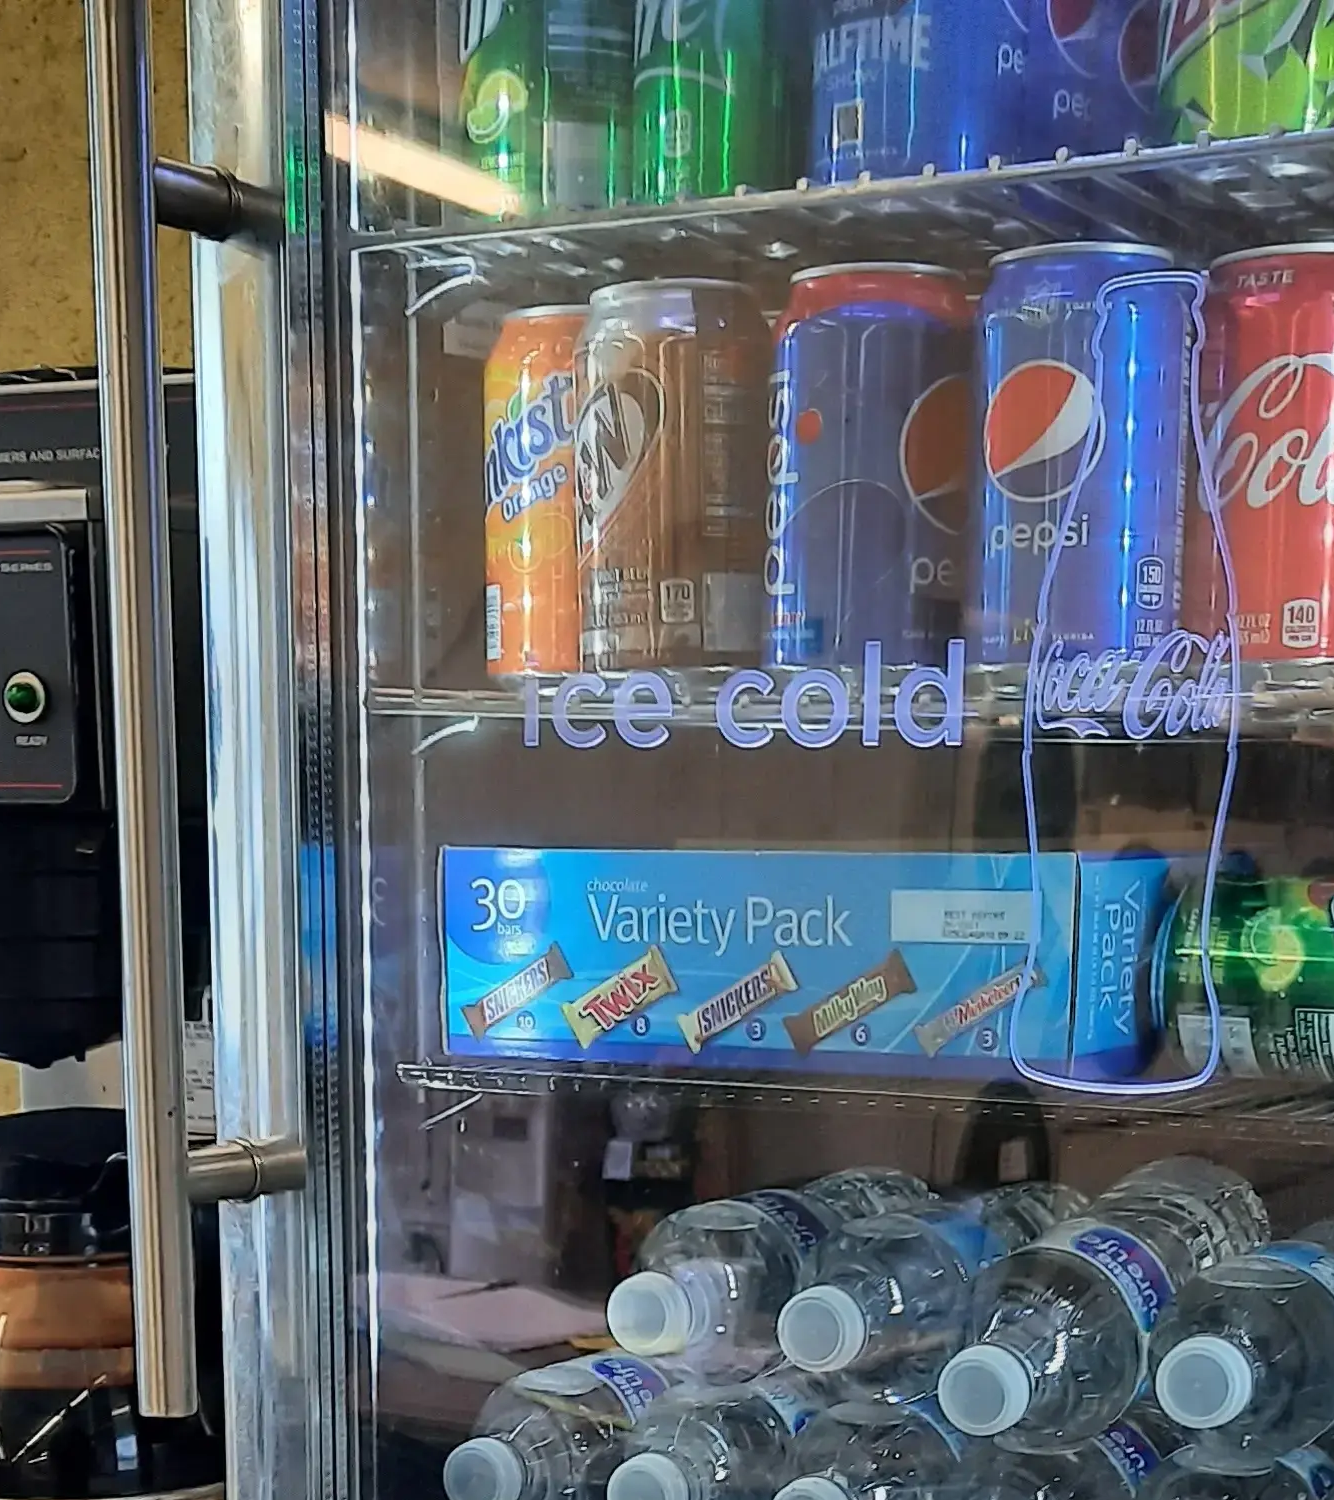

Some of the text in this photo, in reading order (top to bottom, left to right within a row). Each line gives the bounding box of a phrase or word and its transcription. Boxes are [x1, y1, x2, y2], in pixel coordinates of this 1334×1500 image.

[1053, 89, 1091, 119] pe
[1236, 269, 1296, 289] TASTE
[29, 450, 54, 462] AND
[763, 368, 799, 597] pepsi
[990, 513, 1090, 558] pepsi
[1141, 564, 1162, 584] 150
[1287, 605, 1315, 624] 140
[523, 637, 967, 750] ice cold
[1035, 629, 1233, 739] Coca-Cola
[586, 876, 650, 892] chocolate
[470, 877, 526, 932] 30
[497, 921, 522, 935] bars
[586, 892, 854, 957] Variety Pack
[1098, 903, 1121, 1011] Pack
[1113, 880, 1142, 1036] Variety
[484, 958, 549, 1023] SNICKERS
[701, 969, 771, 1034] SNICKERS
[852, 977, 887, 1008] Way
[635, 1017, 646, 1033] 8
[814, 994, 856, 1034] Milky
[752, 1022, 762, 1038] 3
[854, 1027, 867, 1043] 6
[981, 1030, 993, 1048] 3
